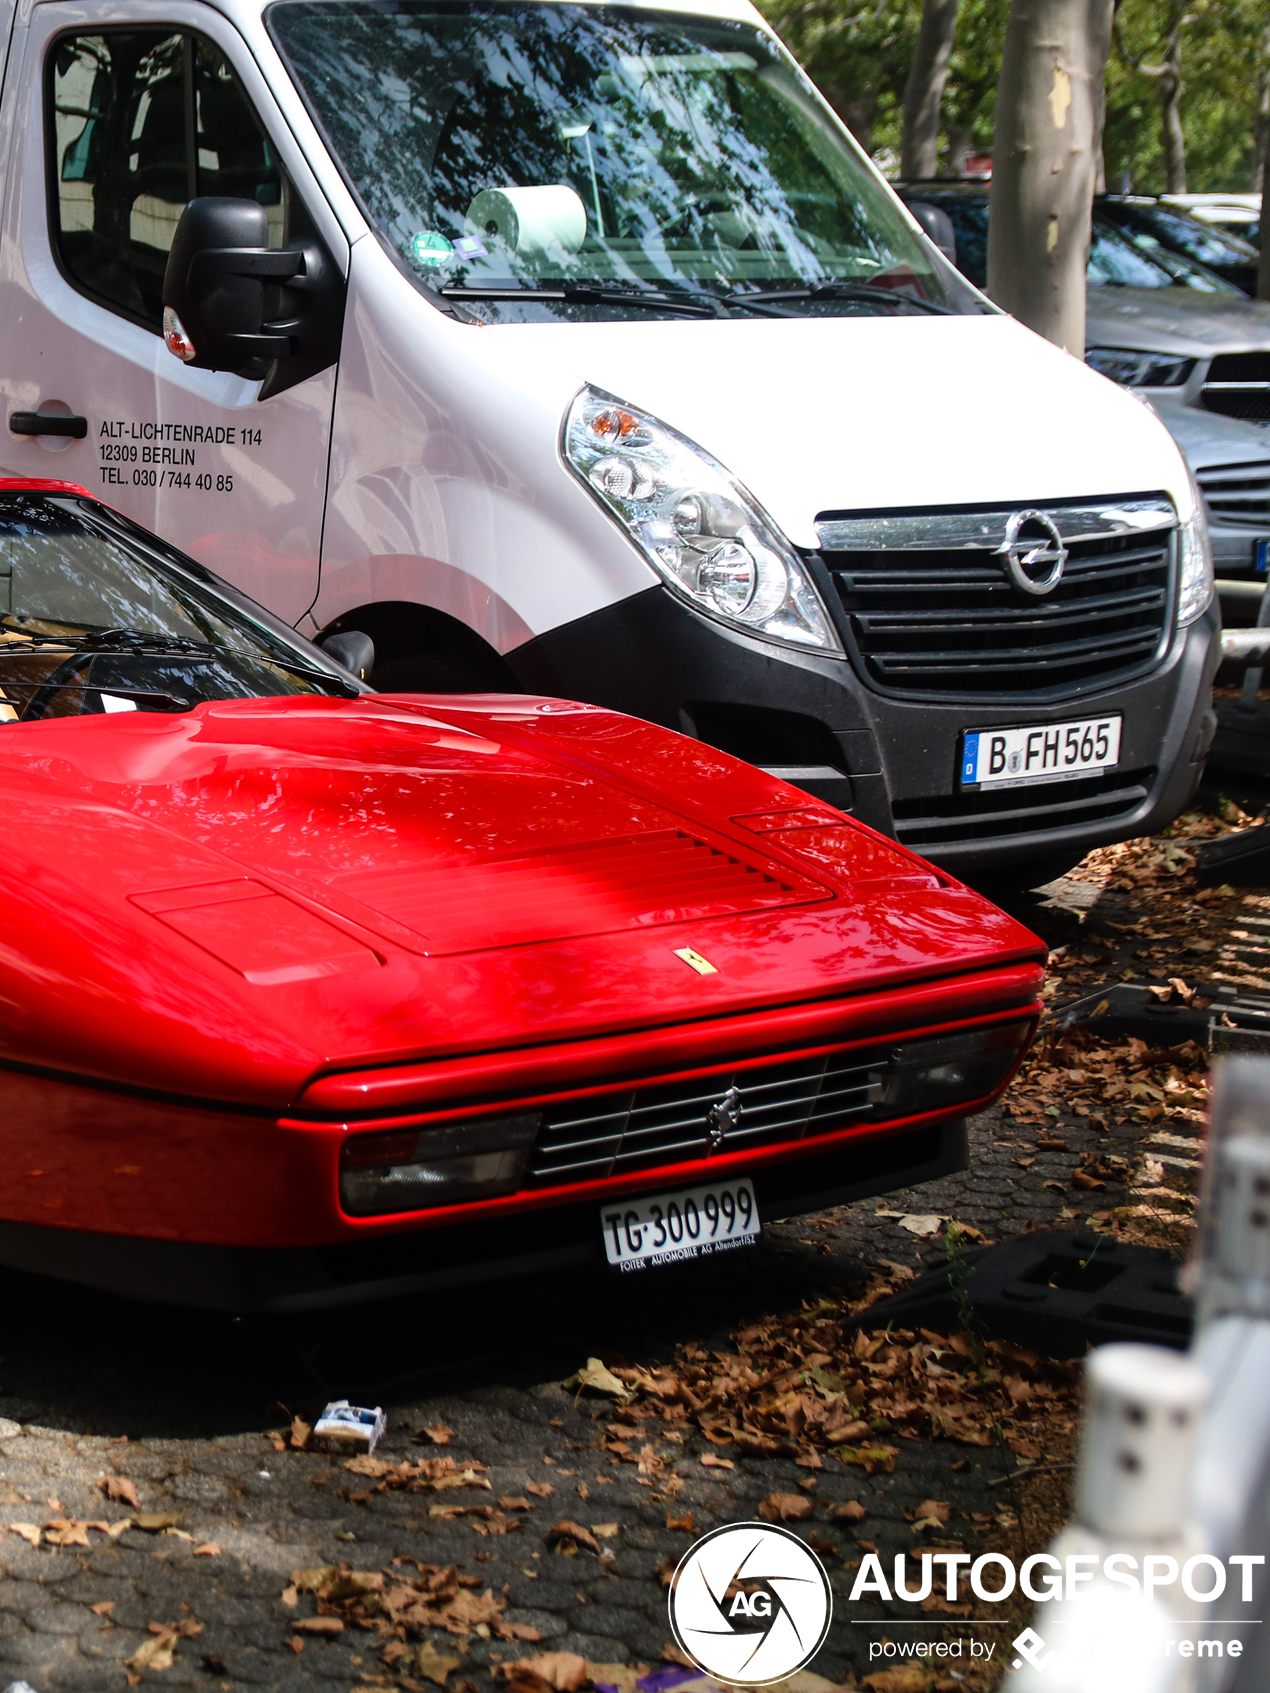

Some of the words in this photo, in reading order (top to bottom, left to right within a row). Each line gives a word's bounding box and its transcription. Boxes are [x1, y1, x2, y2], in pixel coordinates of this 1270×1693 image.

[100, 421, 235, 444] ALT-LICHTENRADE
[240, 428, 262, 446] 114
[100, 444, 138, 462] 12309
[142, 446, 195, 466] BERLIN
[100, 466, 129, 485] TEL.
[195, 473, 212, 491] 40
[216, 474, 234, 492] 85
[988, 736, 1006, 775] B
[1025, 729, 1060, 771] FH
[1065, 722, 1111, 765] 565
[965, 763, 974, 775] D
[651, 1246, 698, 1265] AUTOMOBILE
[701, 1242, 713, 1254] AG
